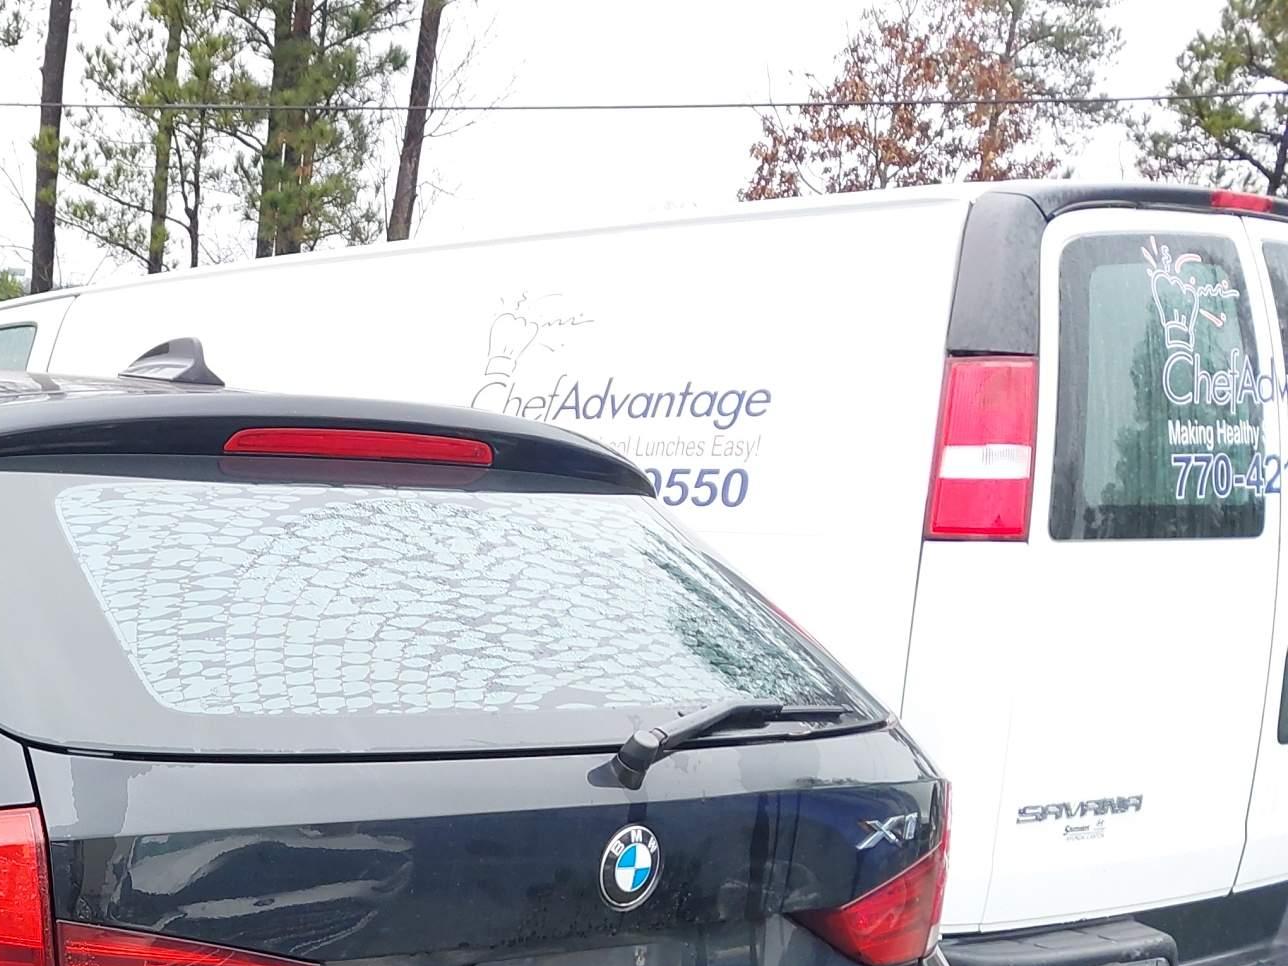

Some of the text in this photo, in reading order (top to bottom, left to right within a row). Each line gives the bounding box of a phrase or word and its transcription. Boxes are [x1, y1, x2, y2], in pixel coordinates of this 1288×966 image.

[471, 374, 772, 430] ChefAdvantage
[635, 435, 708, 457] Lunches
[711, 435, 762, 463] Easy!
[1168, 419, 1260, 450] Making Healthy
[1016, 794, 1143, 824] SAVANA
[611, 829, 658, 856] BMW
[856, 812, 918, 849] X1
